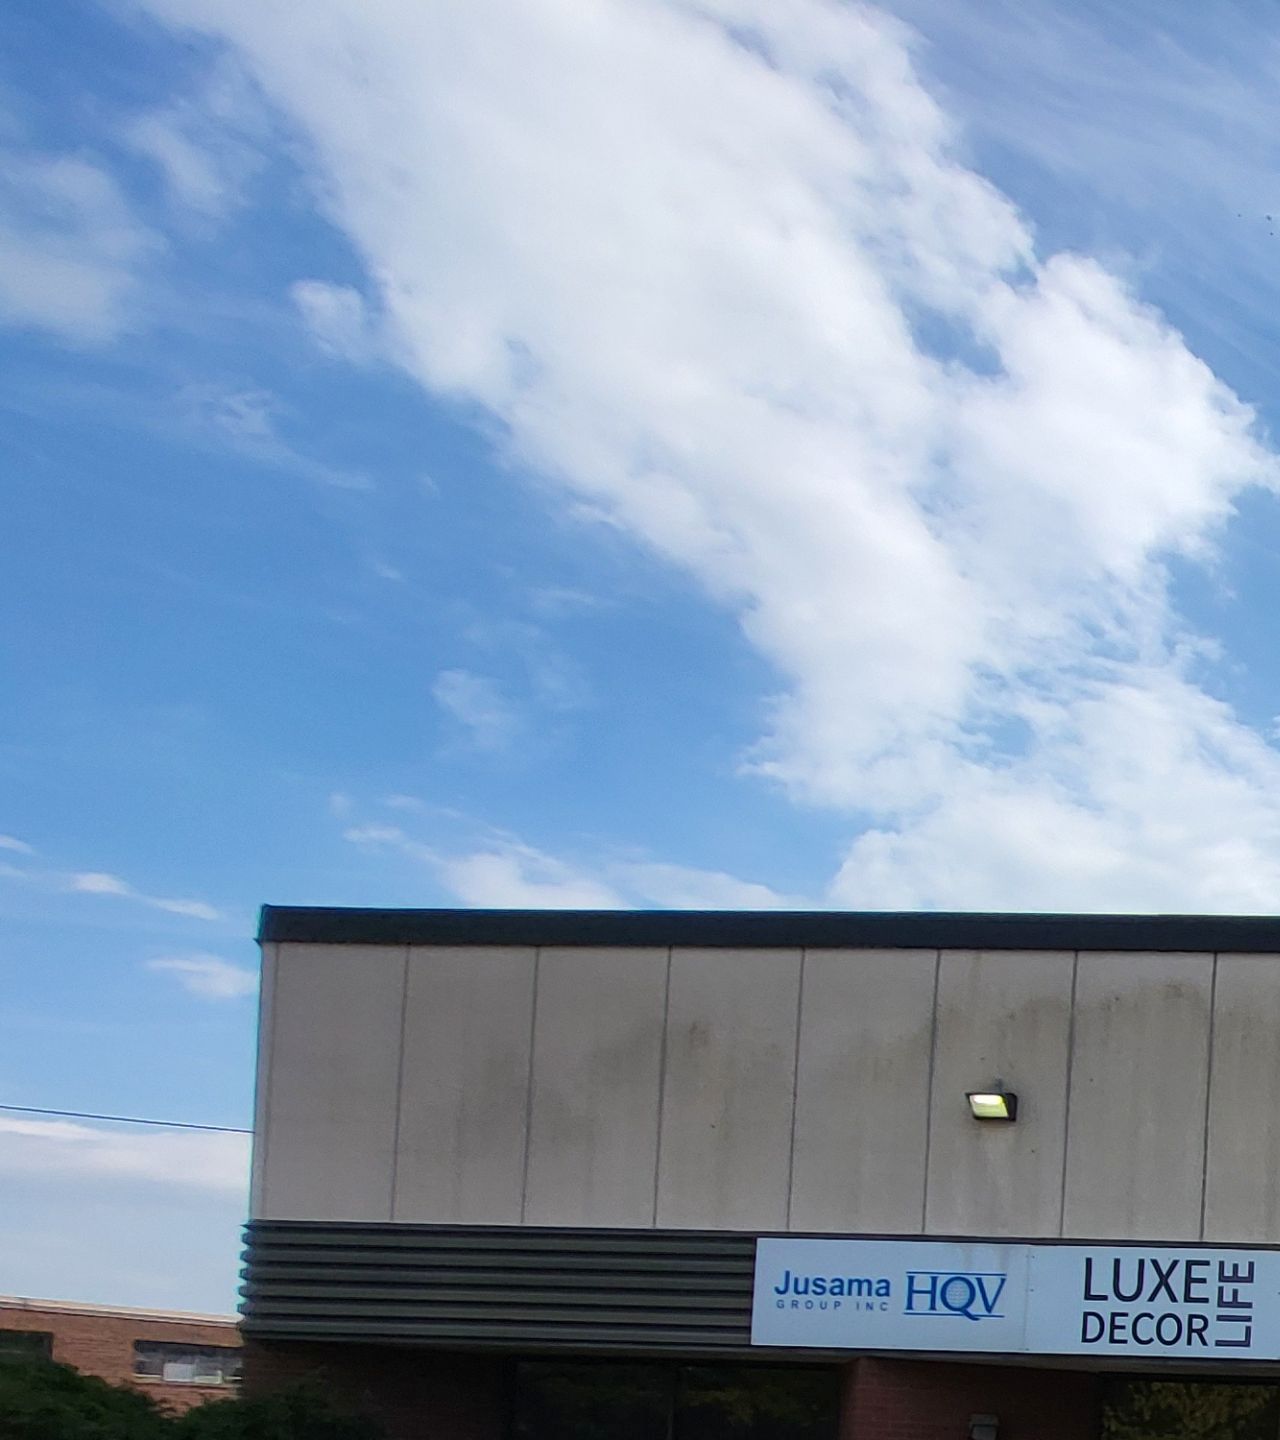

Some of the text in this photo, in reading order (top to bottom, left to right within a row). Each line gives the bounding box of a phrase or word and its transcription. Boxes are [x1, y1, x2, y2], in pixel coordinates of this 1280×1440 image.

[774, 1270, 890, 1297] Jusama
[905, 1274, 1007, 1321] HQV
[1083, 1257, 1211, 1304] LUXE
[776, 1299, 889, 1312] GROUP INC
[1214, 1260, 1255, 1348] LIFE
[1081, 1311, 1209, 1347] DECOR
